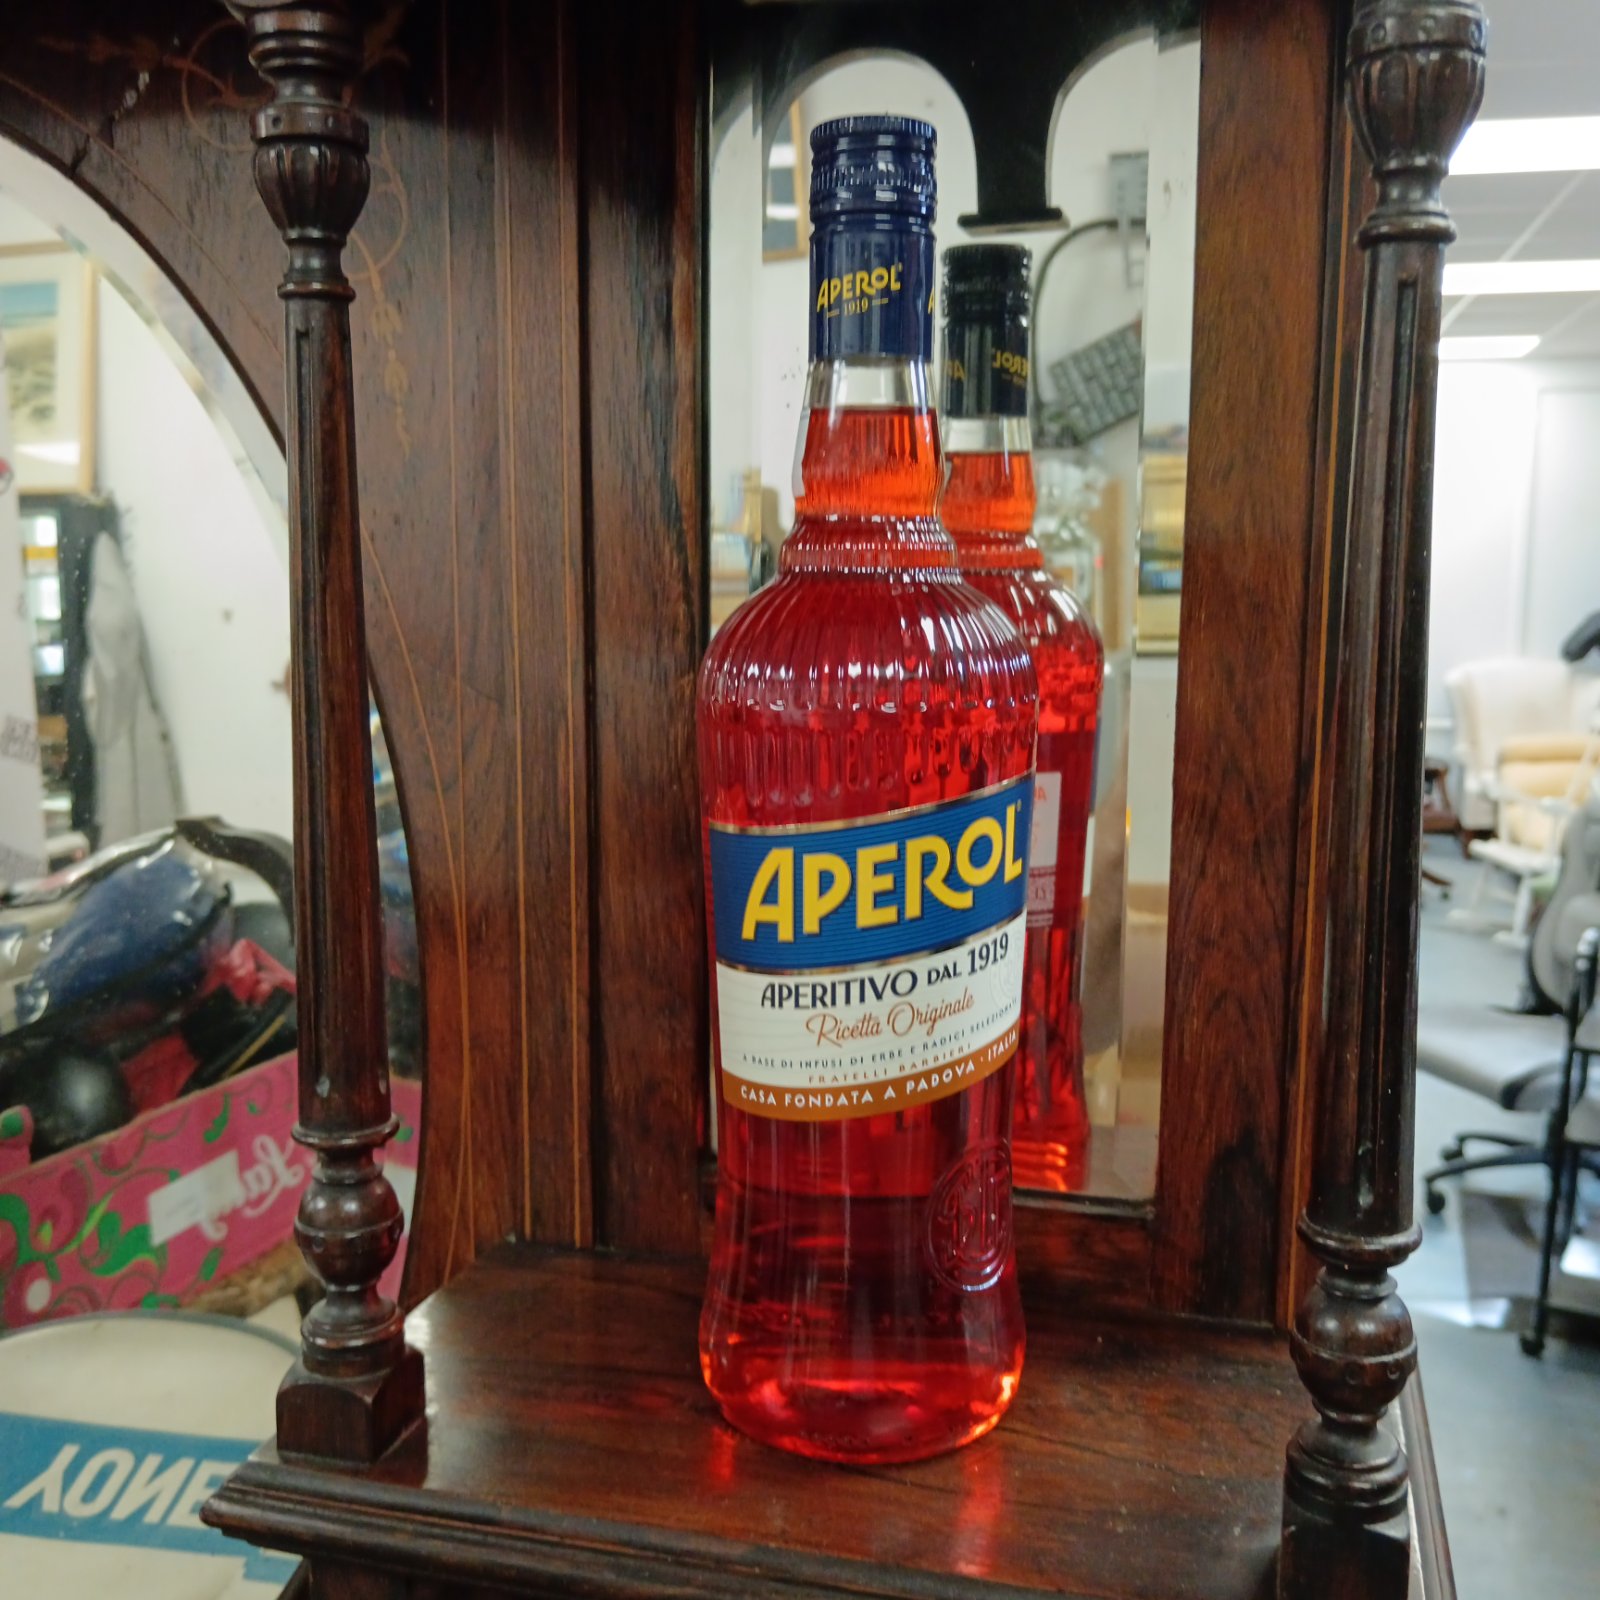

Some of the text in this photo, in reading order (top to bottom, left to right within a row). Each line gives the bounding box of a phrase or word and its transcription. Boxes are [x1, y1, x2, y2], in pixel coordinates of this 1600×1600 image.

[817, 264, 902, 312] APEROL
[741, 803, 1023, 942] APEROL
[761, 932, 1009, 1009] APERITIVO DAL 1919
[805, 986, 974, 1048] Ricetta Originale
[741, 1028, 1018, 1109] CASA FONDATA A PADOVA ITALIA
[752, 1056, 776, 1068] BASE
[781, 1060, 793, 1069] DI
[799, 1057, 843, 1070] INFUSI
[851, 1055, 865, 1066] DI
[872, 1049, 903, 1063] ERBE
[923, 1028, 966, 1052] RADICI
[808, 1042, 972, 1085] FRATELLI BARBIERI
